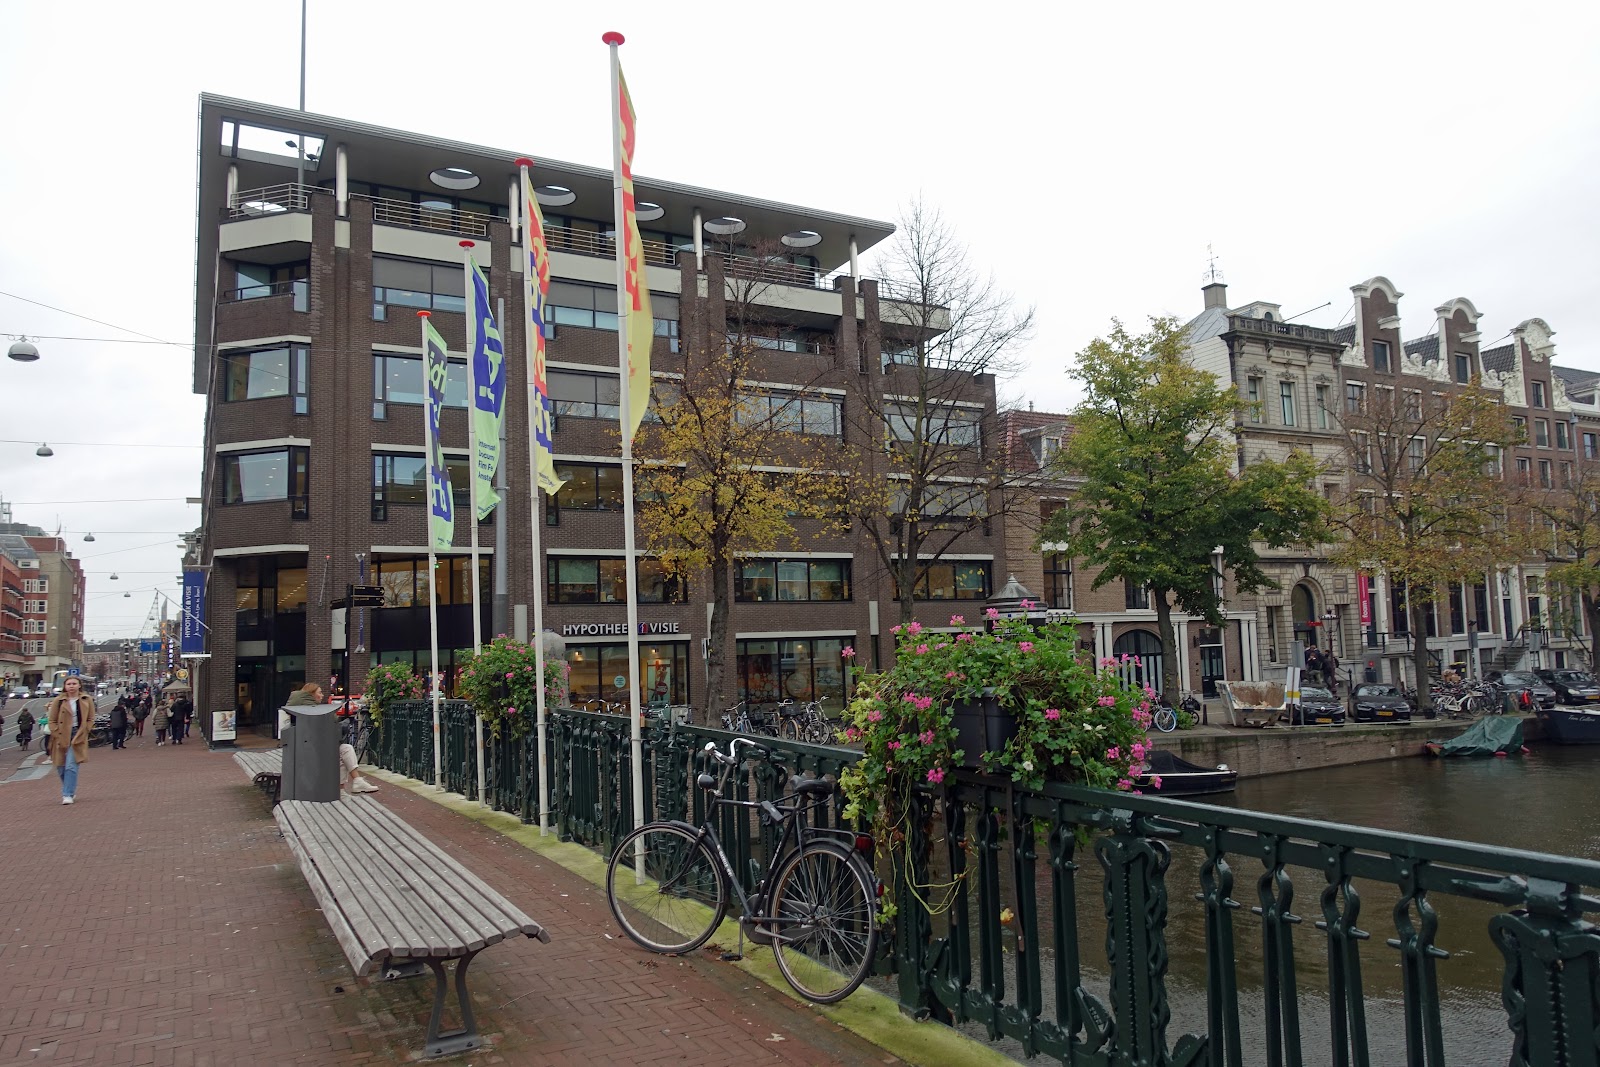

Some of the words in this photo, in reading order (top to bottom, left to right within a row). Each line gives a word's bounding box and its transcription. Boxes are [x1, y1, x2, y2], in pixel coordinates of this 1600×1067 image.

[478, 460, 487, 470] Film
[563, 623, 628, 635] HYPOTHEE
[649, 622, 679, 633] VISIE
